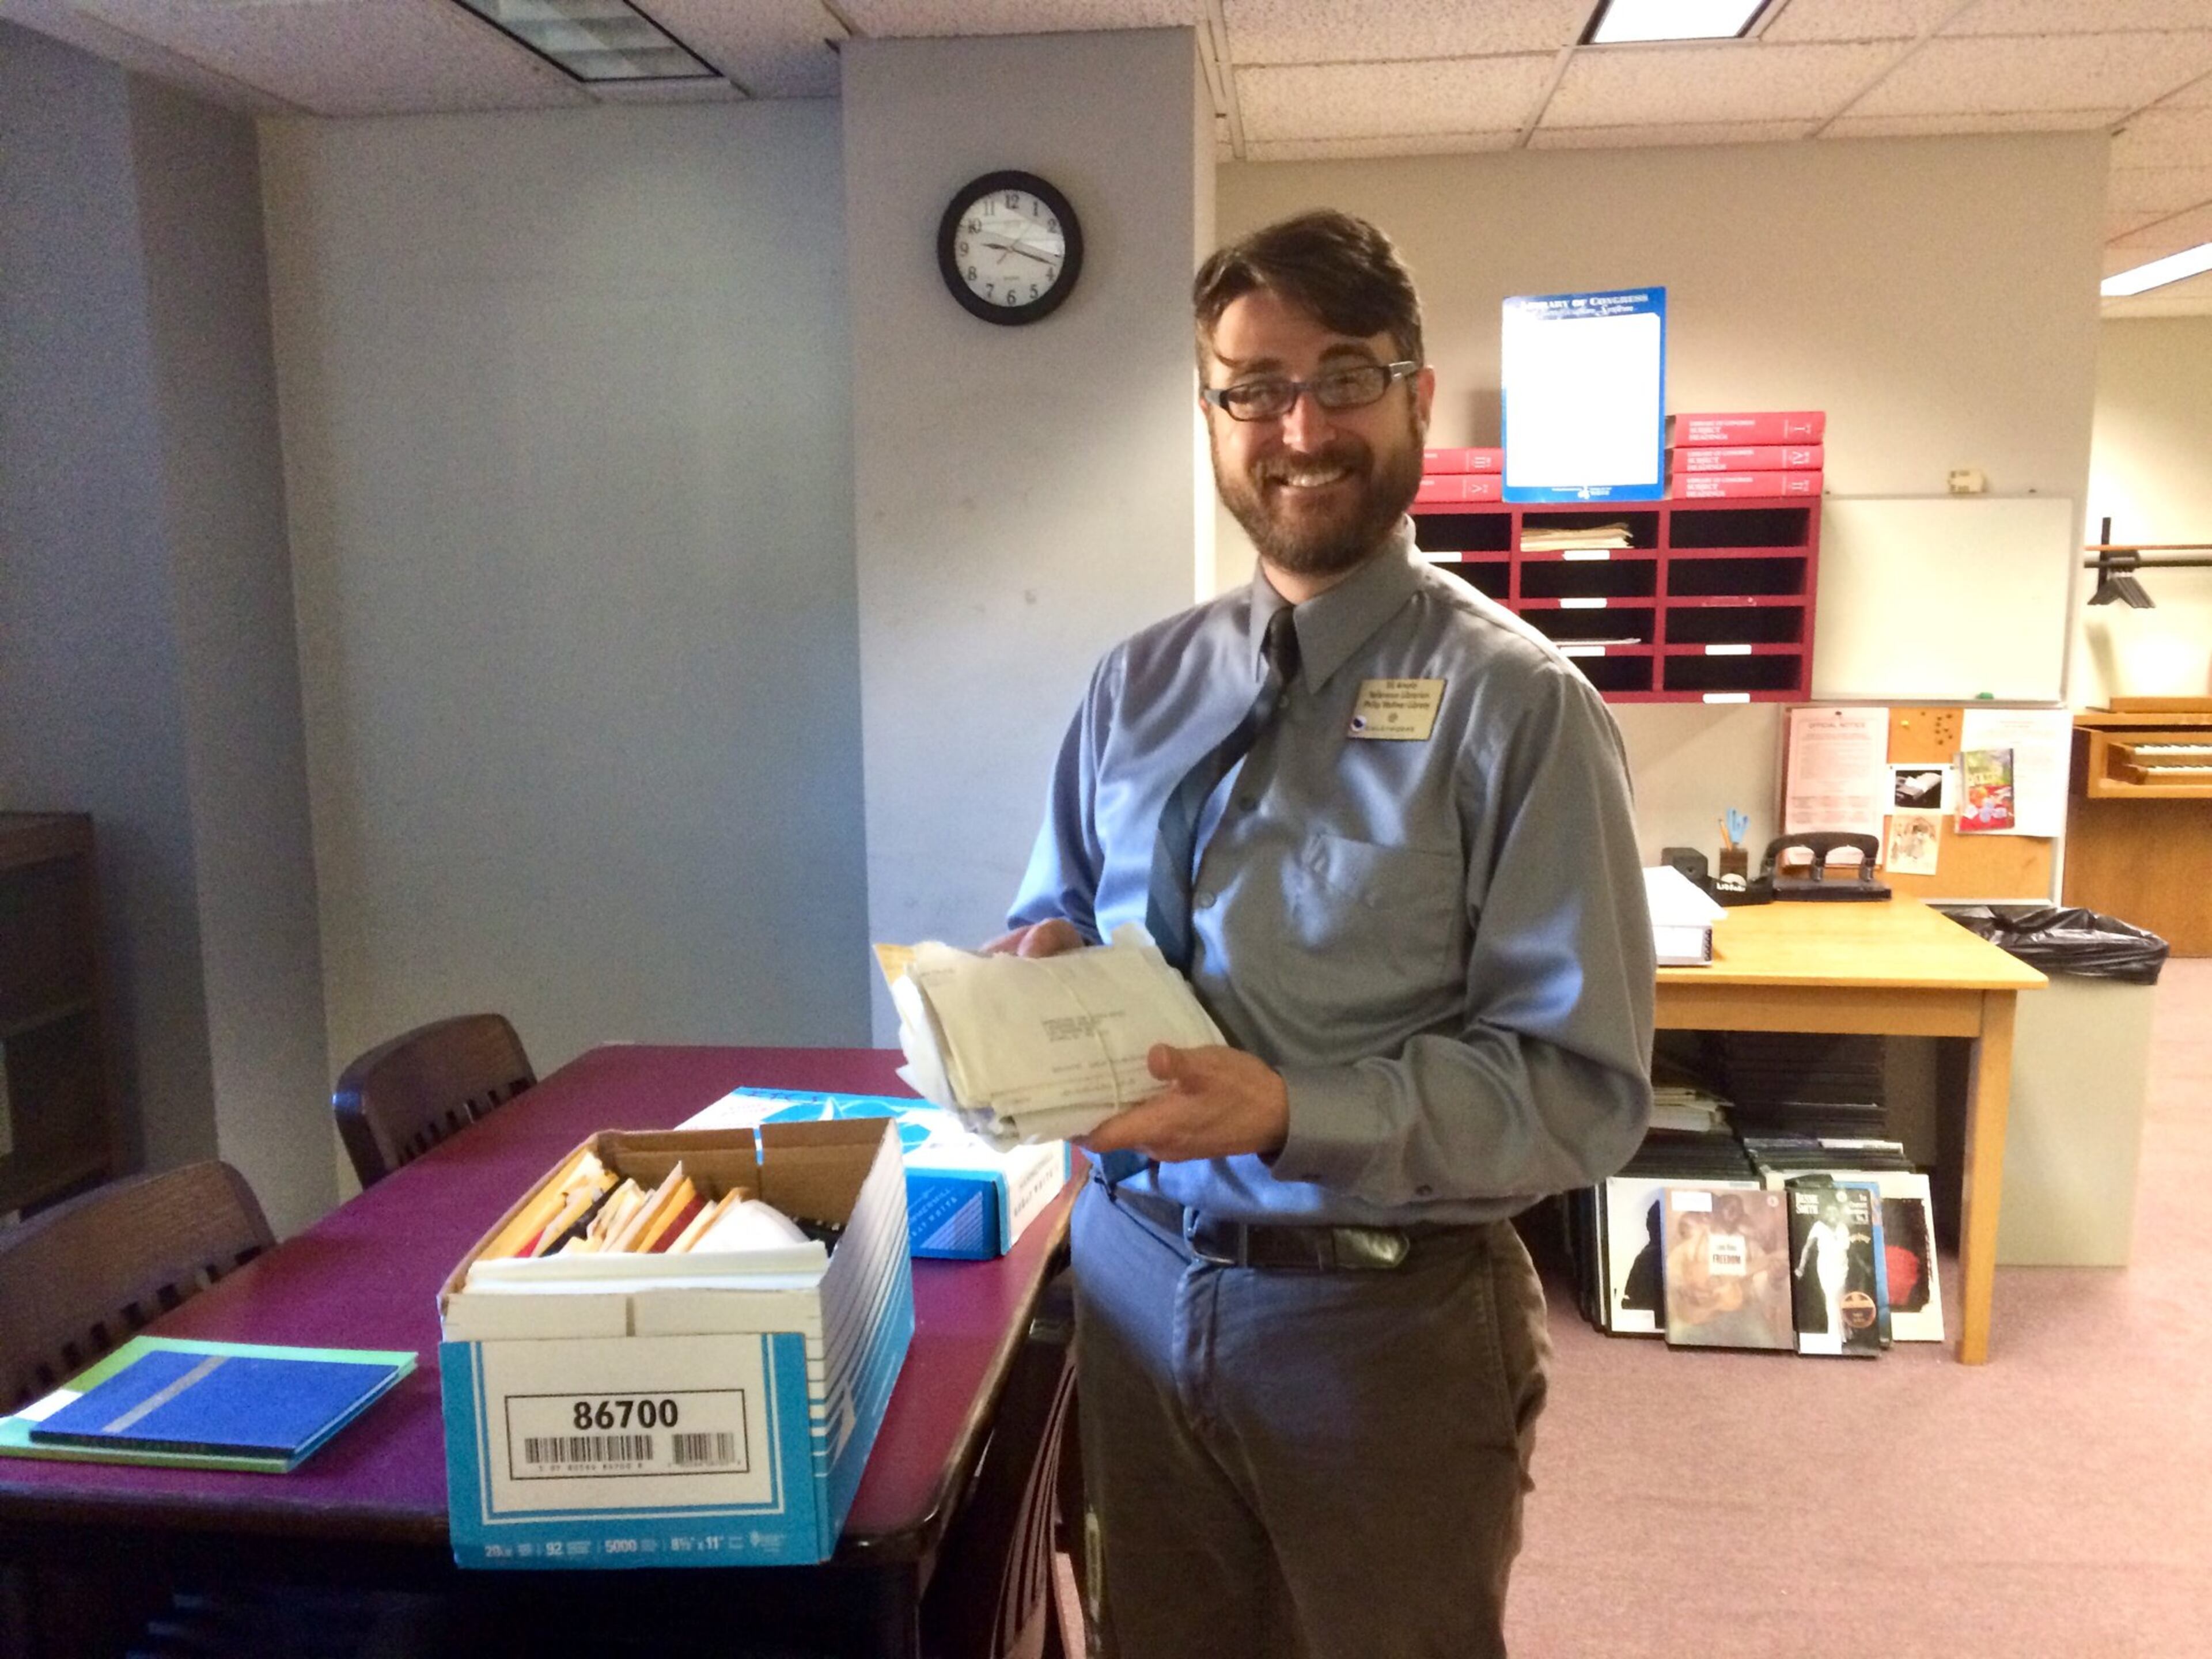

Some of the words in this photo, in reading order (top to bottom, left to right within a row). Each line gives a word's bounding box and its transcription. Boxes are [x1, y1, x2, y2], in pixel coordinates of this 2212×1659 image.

[983, 201, 995, 216] 11
[1005, 194, 1020, 209] 12
[968, 266, 977, 281] 8
[985, 283, 994, 298] 7
[1007, 290, 1016, 304] 6
[1029, 284, 1038, 298] 5
[573, 1399, 679, 1430] 86700
[546, 1542, 562, 1556] 92
[605, 1539, 638, 1554] 5000
